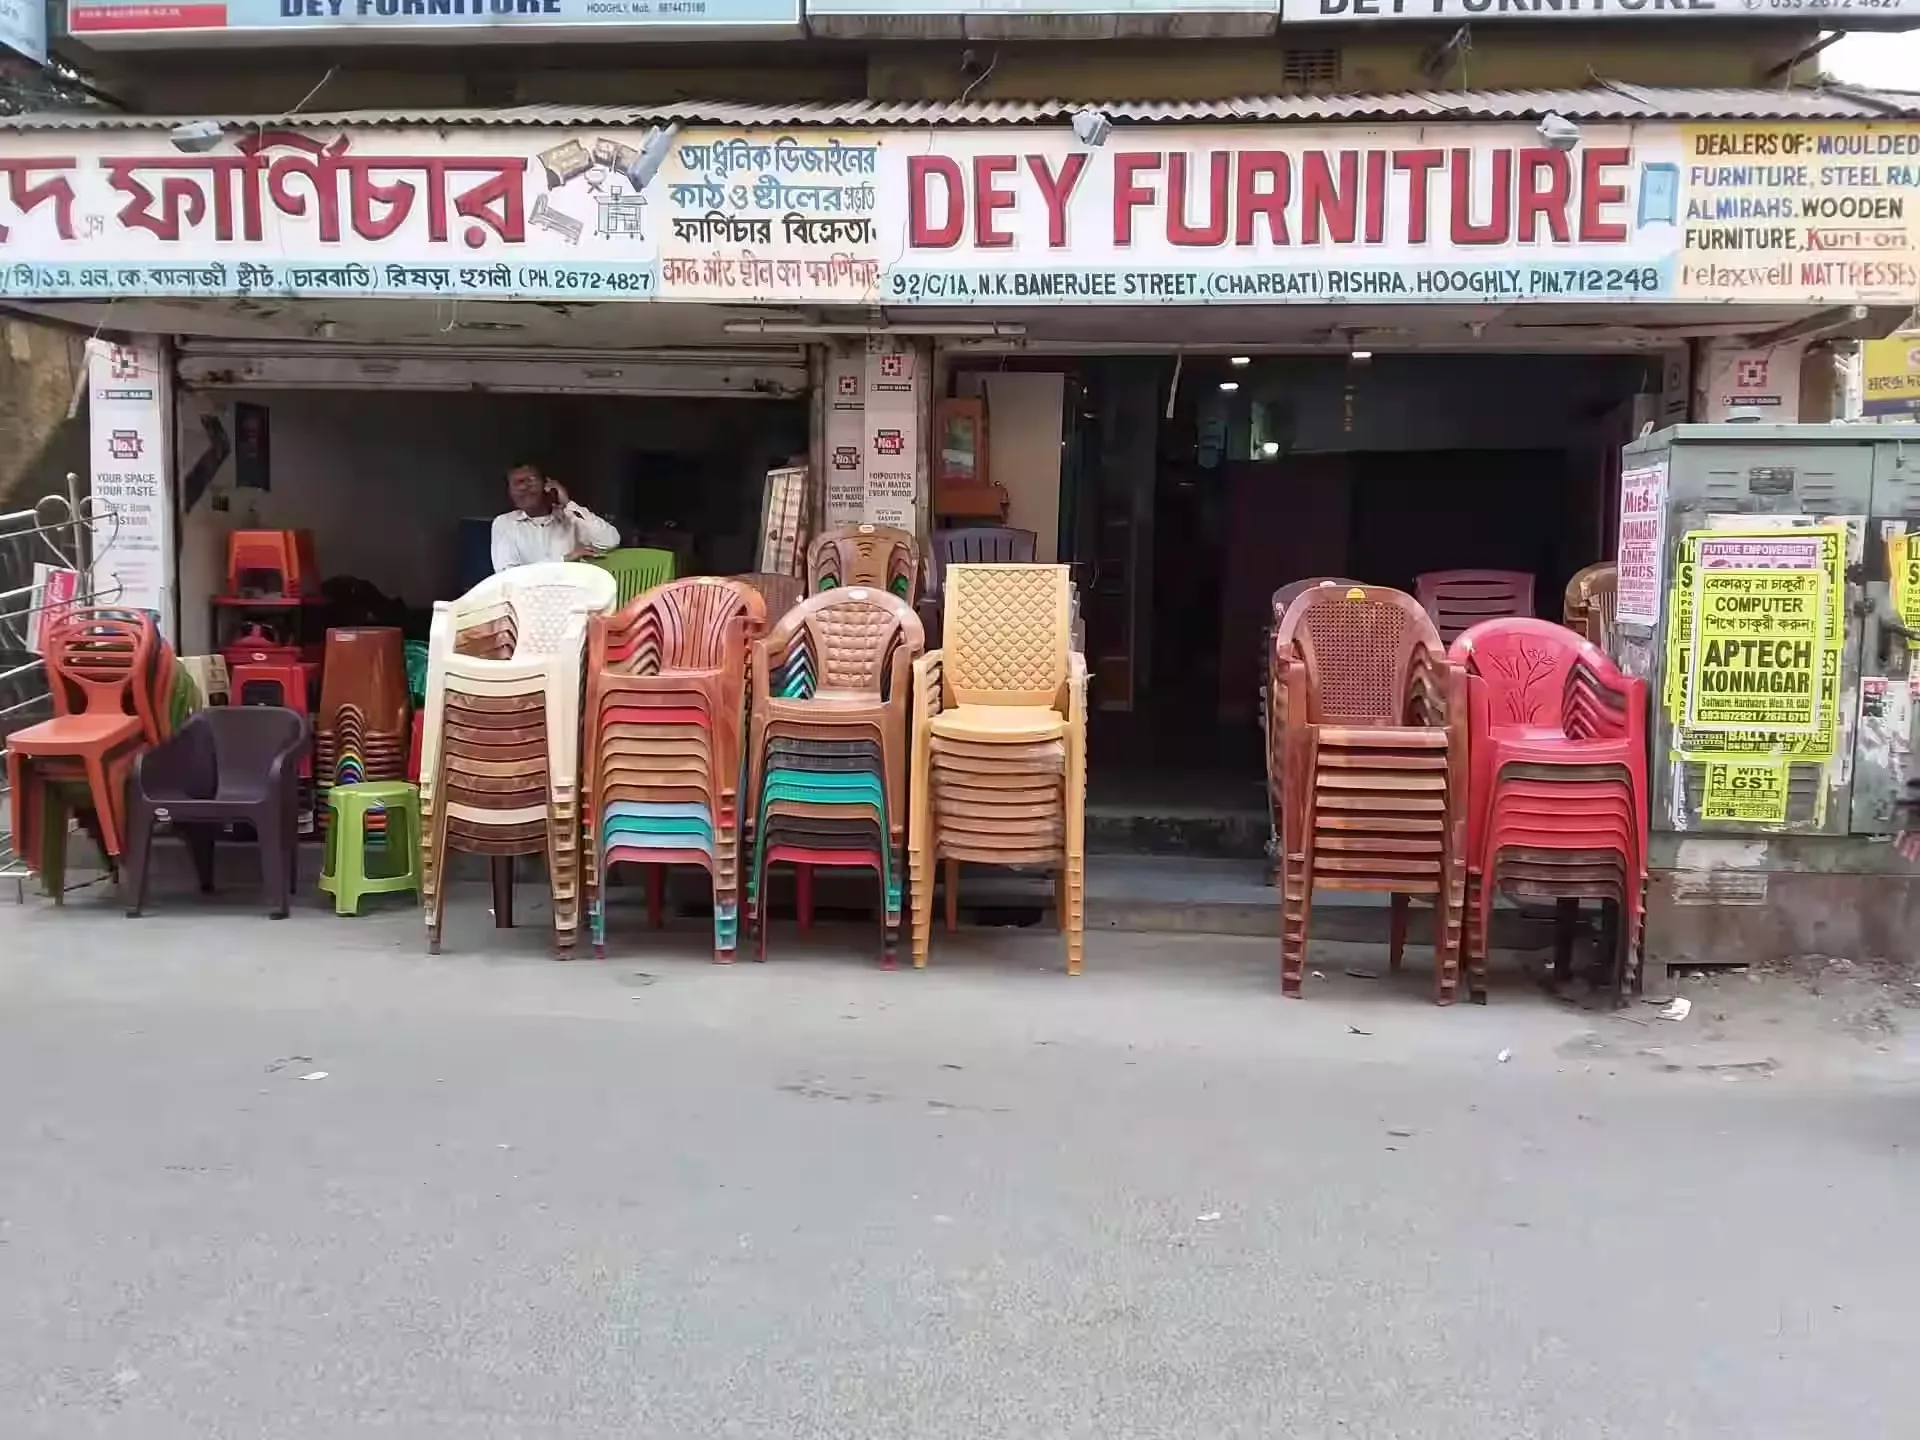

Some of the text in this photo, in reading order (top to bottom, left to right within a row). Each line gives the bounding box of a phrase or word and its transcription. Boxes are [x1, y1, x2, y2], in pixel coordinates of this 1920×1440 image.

[1695, 133, 1778, 156] DEALERS
[1817, 134, 1920, 155] MOULDED
[678, 137, 772, 179] আধুনিক
[1820, 166, 1882, 187] STEEL
[668, 174, 725, 209] কাঠ
[729, 184, 748, 210] ও
[906, 147, 1630, 248] DEY FURNITURE
[1802, 196, 1904, 219] WOODEN
[878, 437, 899, 449] No.1
[97, 472, 121, 483] YOUR
[98, 486, 122, 497] YOUR
[1703, 544, 1741, 555] FUTURE
[1715, 596, 1804, 613] COMPUTER
[1703, 639, 1811, 669] APTECH
[1702, 670, 1810, 694] KONNAGAR
[1737, 767, 1773, 777] WITH
[1731, 776, 1779, 790] GST
